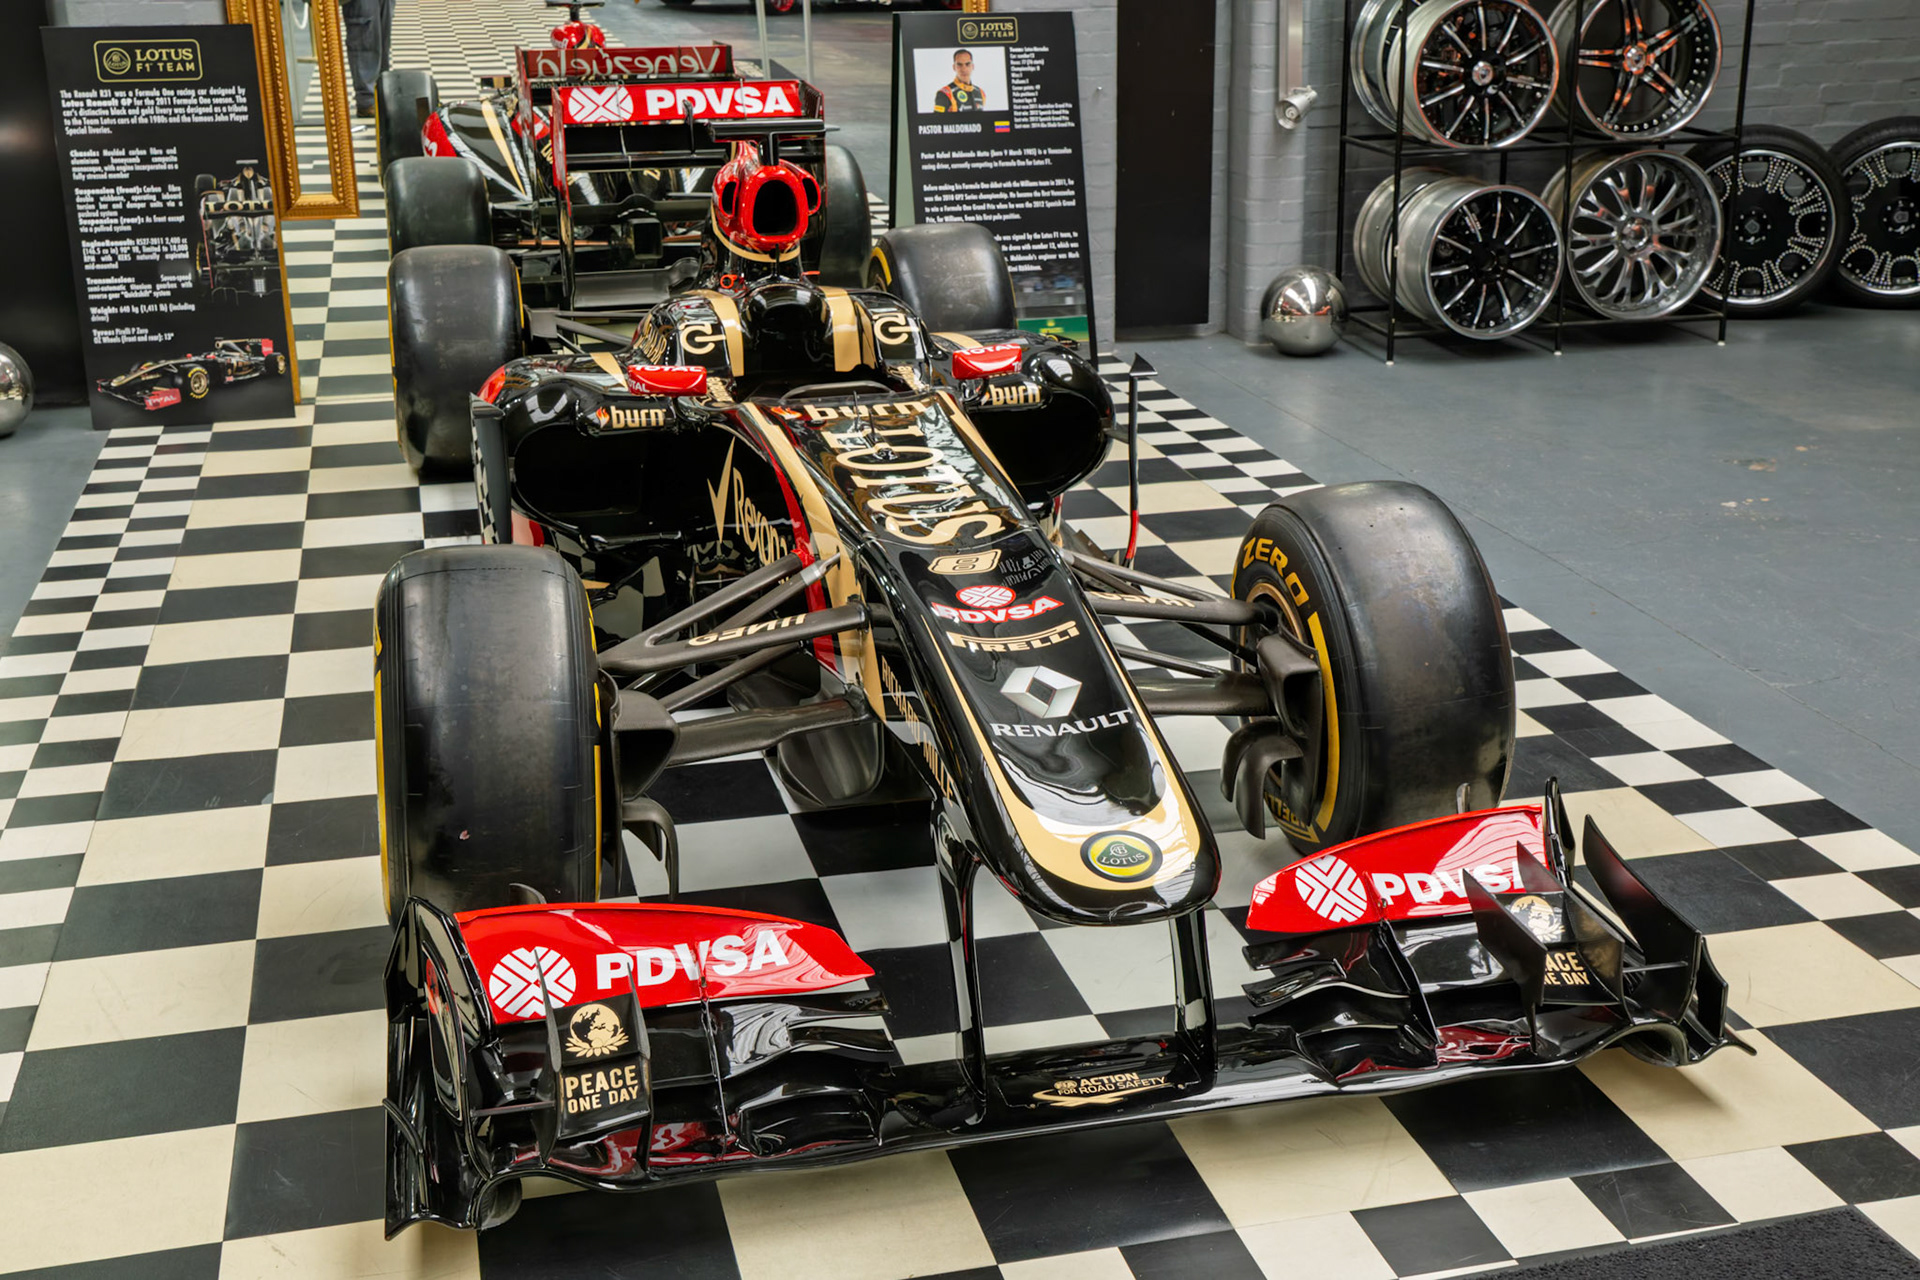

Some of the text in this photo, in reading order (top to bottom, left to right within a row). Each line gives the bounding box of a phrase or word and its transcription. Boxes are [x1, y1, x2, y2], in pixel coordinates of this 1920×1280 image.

[980, 22, 1014, 31] LOTUS
[135, 48, 193, 61] LOTUS
[136, 62, 195, 72] F1 TEAM
[61, 89, 72, 98] The
[74, 89, 97, 97] Renault
[135, 88, 160, 96] Formula
[162, 88, 174, 96] One
[177, 87, 195, 97] racing
[209, 87, 236, 97] designed
[238, 86, 245, 96] by
[61, 99, 84, 107] Lotus
[86, 98, 118, 107] Renault
[121, 98, 132, 106] GP
[134, 97, 143, 105] for
[144, 97, 154, 105] the
[156, 97, 171, 105] 2011
[173, 96, 197, 105] Formula
[199, 96, 211, 104] One
[236, 95, 246, 103] The
[646, 86, 794, 116] PDVSA
[64, 117, 71, 125] to
[72, 117, 82, 125] the
[83, 117, 99, 125] Team
[100, 116, 116, 124] Lotus
[131, 116, 137, 124] of
[138, 115, 148, 124] the
[150, 115, 167, 123] 1980s
[169, 115, 180, 123] and
[181, 114, 191, 123] the
[215, 114, 229, 122] John
[230, 113, 248, 123] Player
[110, 107, 126, 115] black
[128, 106, 139, 115] and
[141, 106, 154, 116] gold
[155, 106, 172, 116] livery
[186, 105, 213, 115] designed
[228, 104, 247, 112] tribute
[65, 126, 87, 136] Special
[918, 123, 982, 135] PASTOR MALDONADO
[989, 384, 1041, 406] burn
[611, 405, 665, 429] burn
[803, 400, 929, 421] burn
[821, 425, 1006, 545] LOTUS
[1242, 536, 1310, 607] ZERO
[932, 596, 1064, 624] PDVSA
[946, 621, 1080, 652] PIRELLI
[881, 655, 921, 746] RICHARD
[990, 708, 1133, 737] RENAULT
[1101, 852, 1145, 865] LOTUS
[596, 929, 791, 990] PDVSA
[1545, 951, 1584, 972] ACE
[1560, 971, 1590, 985] DAY
[564, 1064, 639, 1099] PEACE
[1058, 1076, 1166, 1095] FOR ROAD SAFETY
[1080, 1072, 1139, 1087] ACTION
[567, 1084, 641, 1114] ONE DAY
